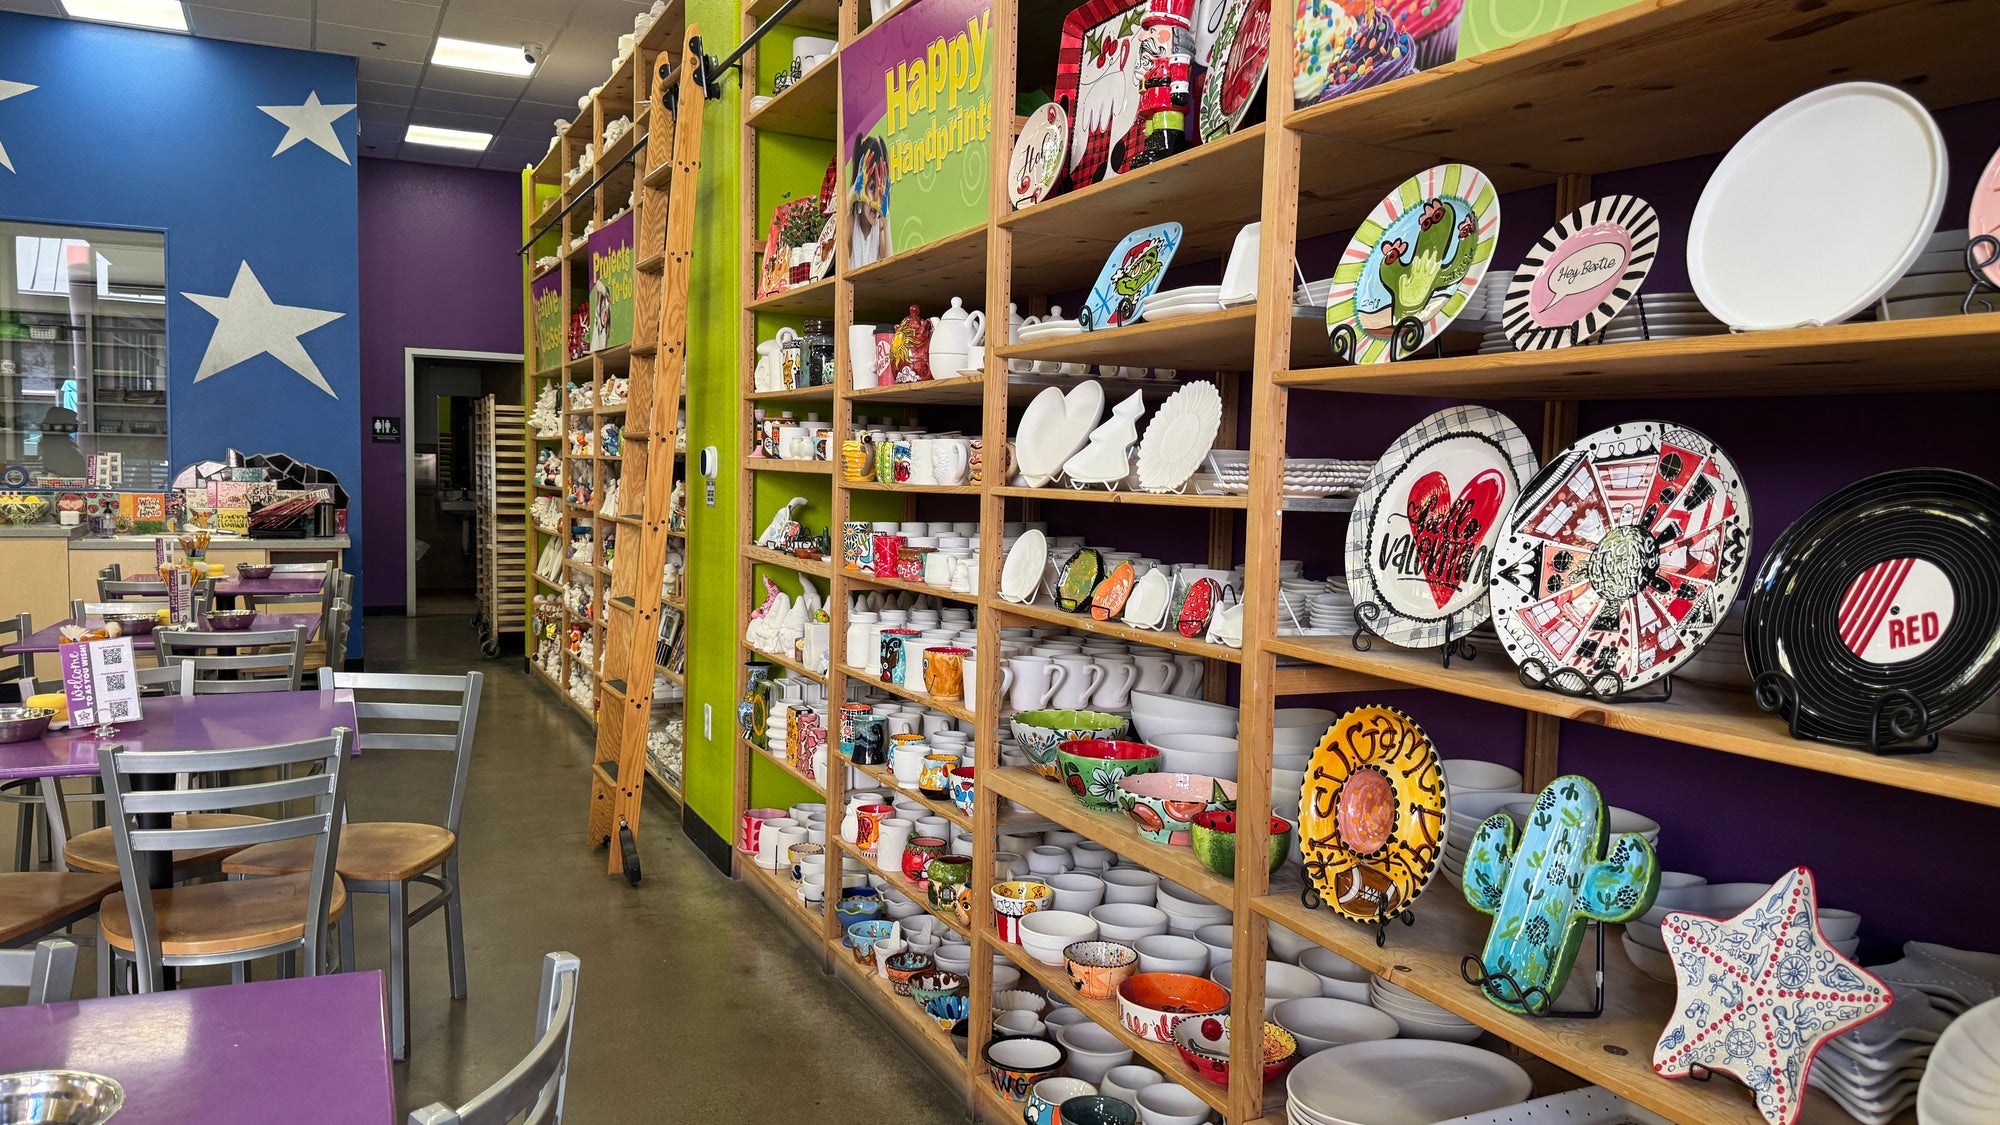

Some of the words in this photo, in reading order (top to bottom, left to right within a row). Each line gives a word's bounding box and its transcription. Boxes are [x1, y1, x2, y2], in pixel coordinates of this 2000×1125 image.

[885, 8, 990, 137] Happy
[592, 239, 631, 285] Projects
[1557, 265, 1582, 285] Hey
[1580, 256, 1617, 276] Bestie
[1387, 495, 1482, 541] hello
[1888, 611, 1940, 650] RED
[79, 644, 88, 668] WISH!
[67, 650, 86, 702] Welcome
[82, 667, 91, 685] YOU
[84, 684, 92, 696] AS
[86, 696, 94, 707] TO
